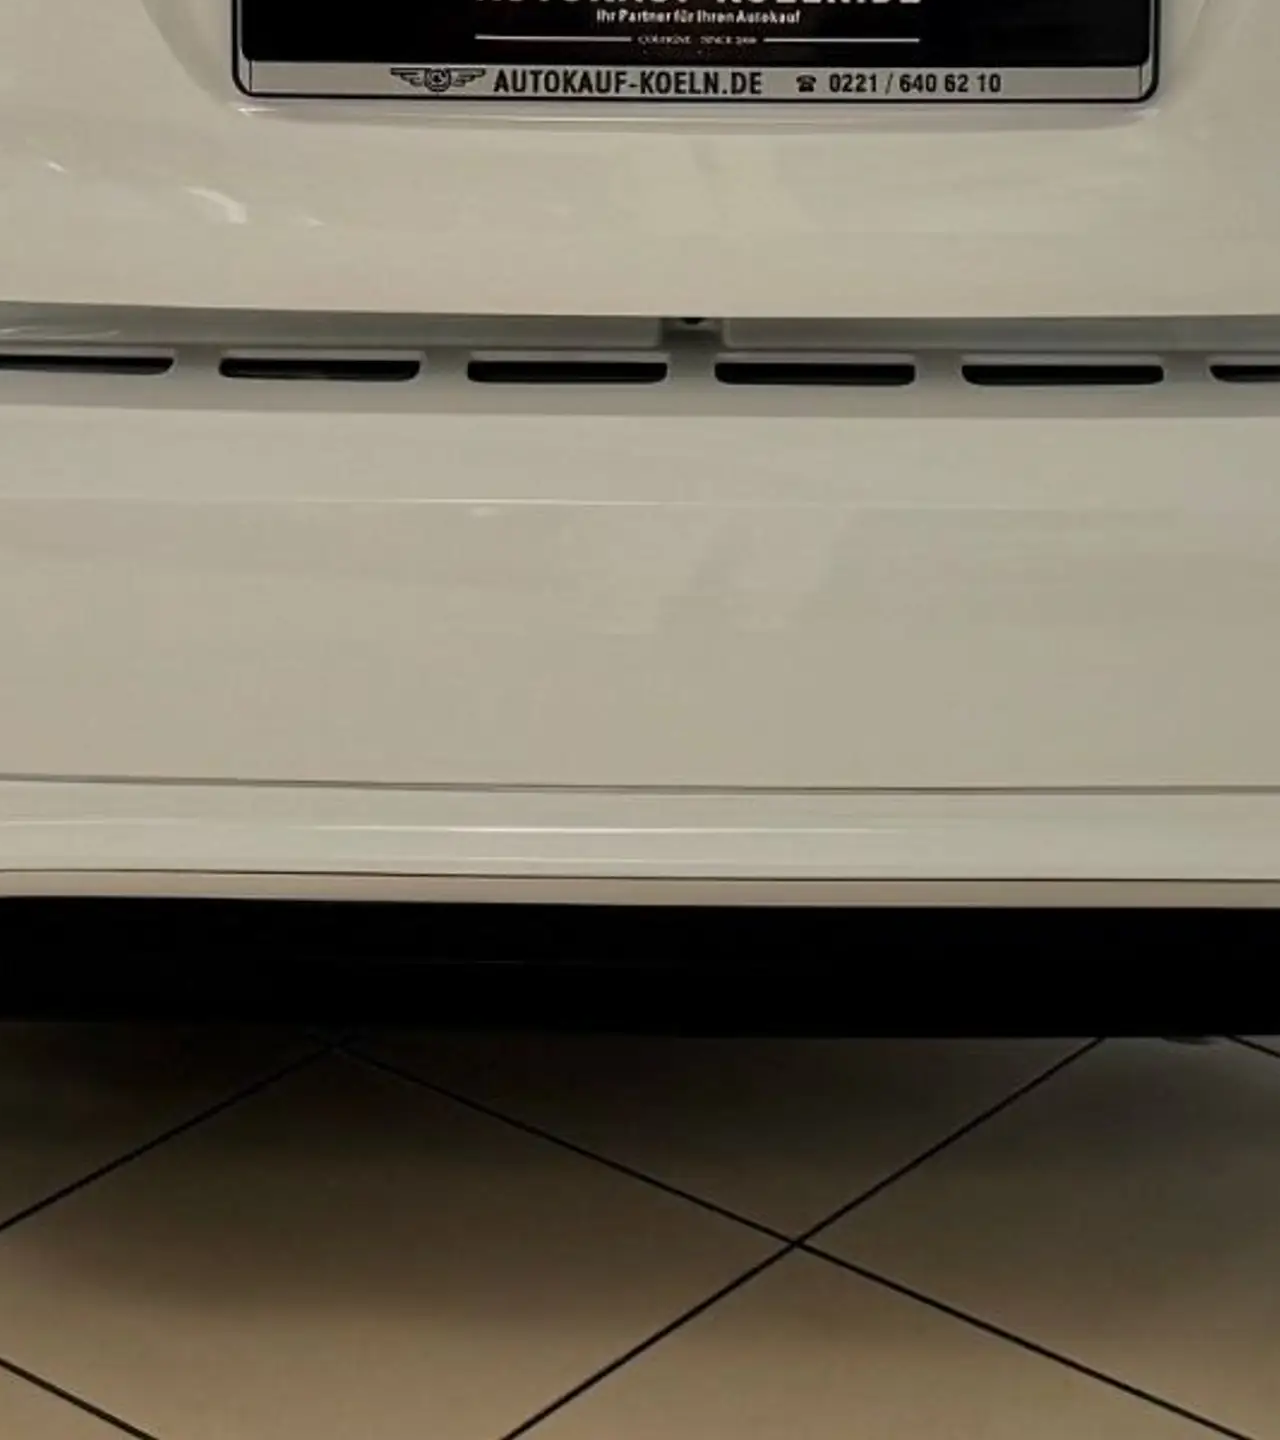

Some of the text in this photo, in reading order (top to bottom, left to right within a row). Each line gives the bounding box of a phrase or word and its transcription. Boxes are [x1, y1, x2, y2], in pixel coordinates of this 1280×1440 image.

[596, 9, 616, 23] Ihr
[619, 9, 671, 23] Partner
[493, 69, 763, 94] AUTOKAUF-KOELN.DE
[829, 73, 877, 92] 0221
[899, 73, 937, 93] 640
[944, 73, 969, 93] 62
[977, 73, 1002, 93] 10
